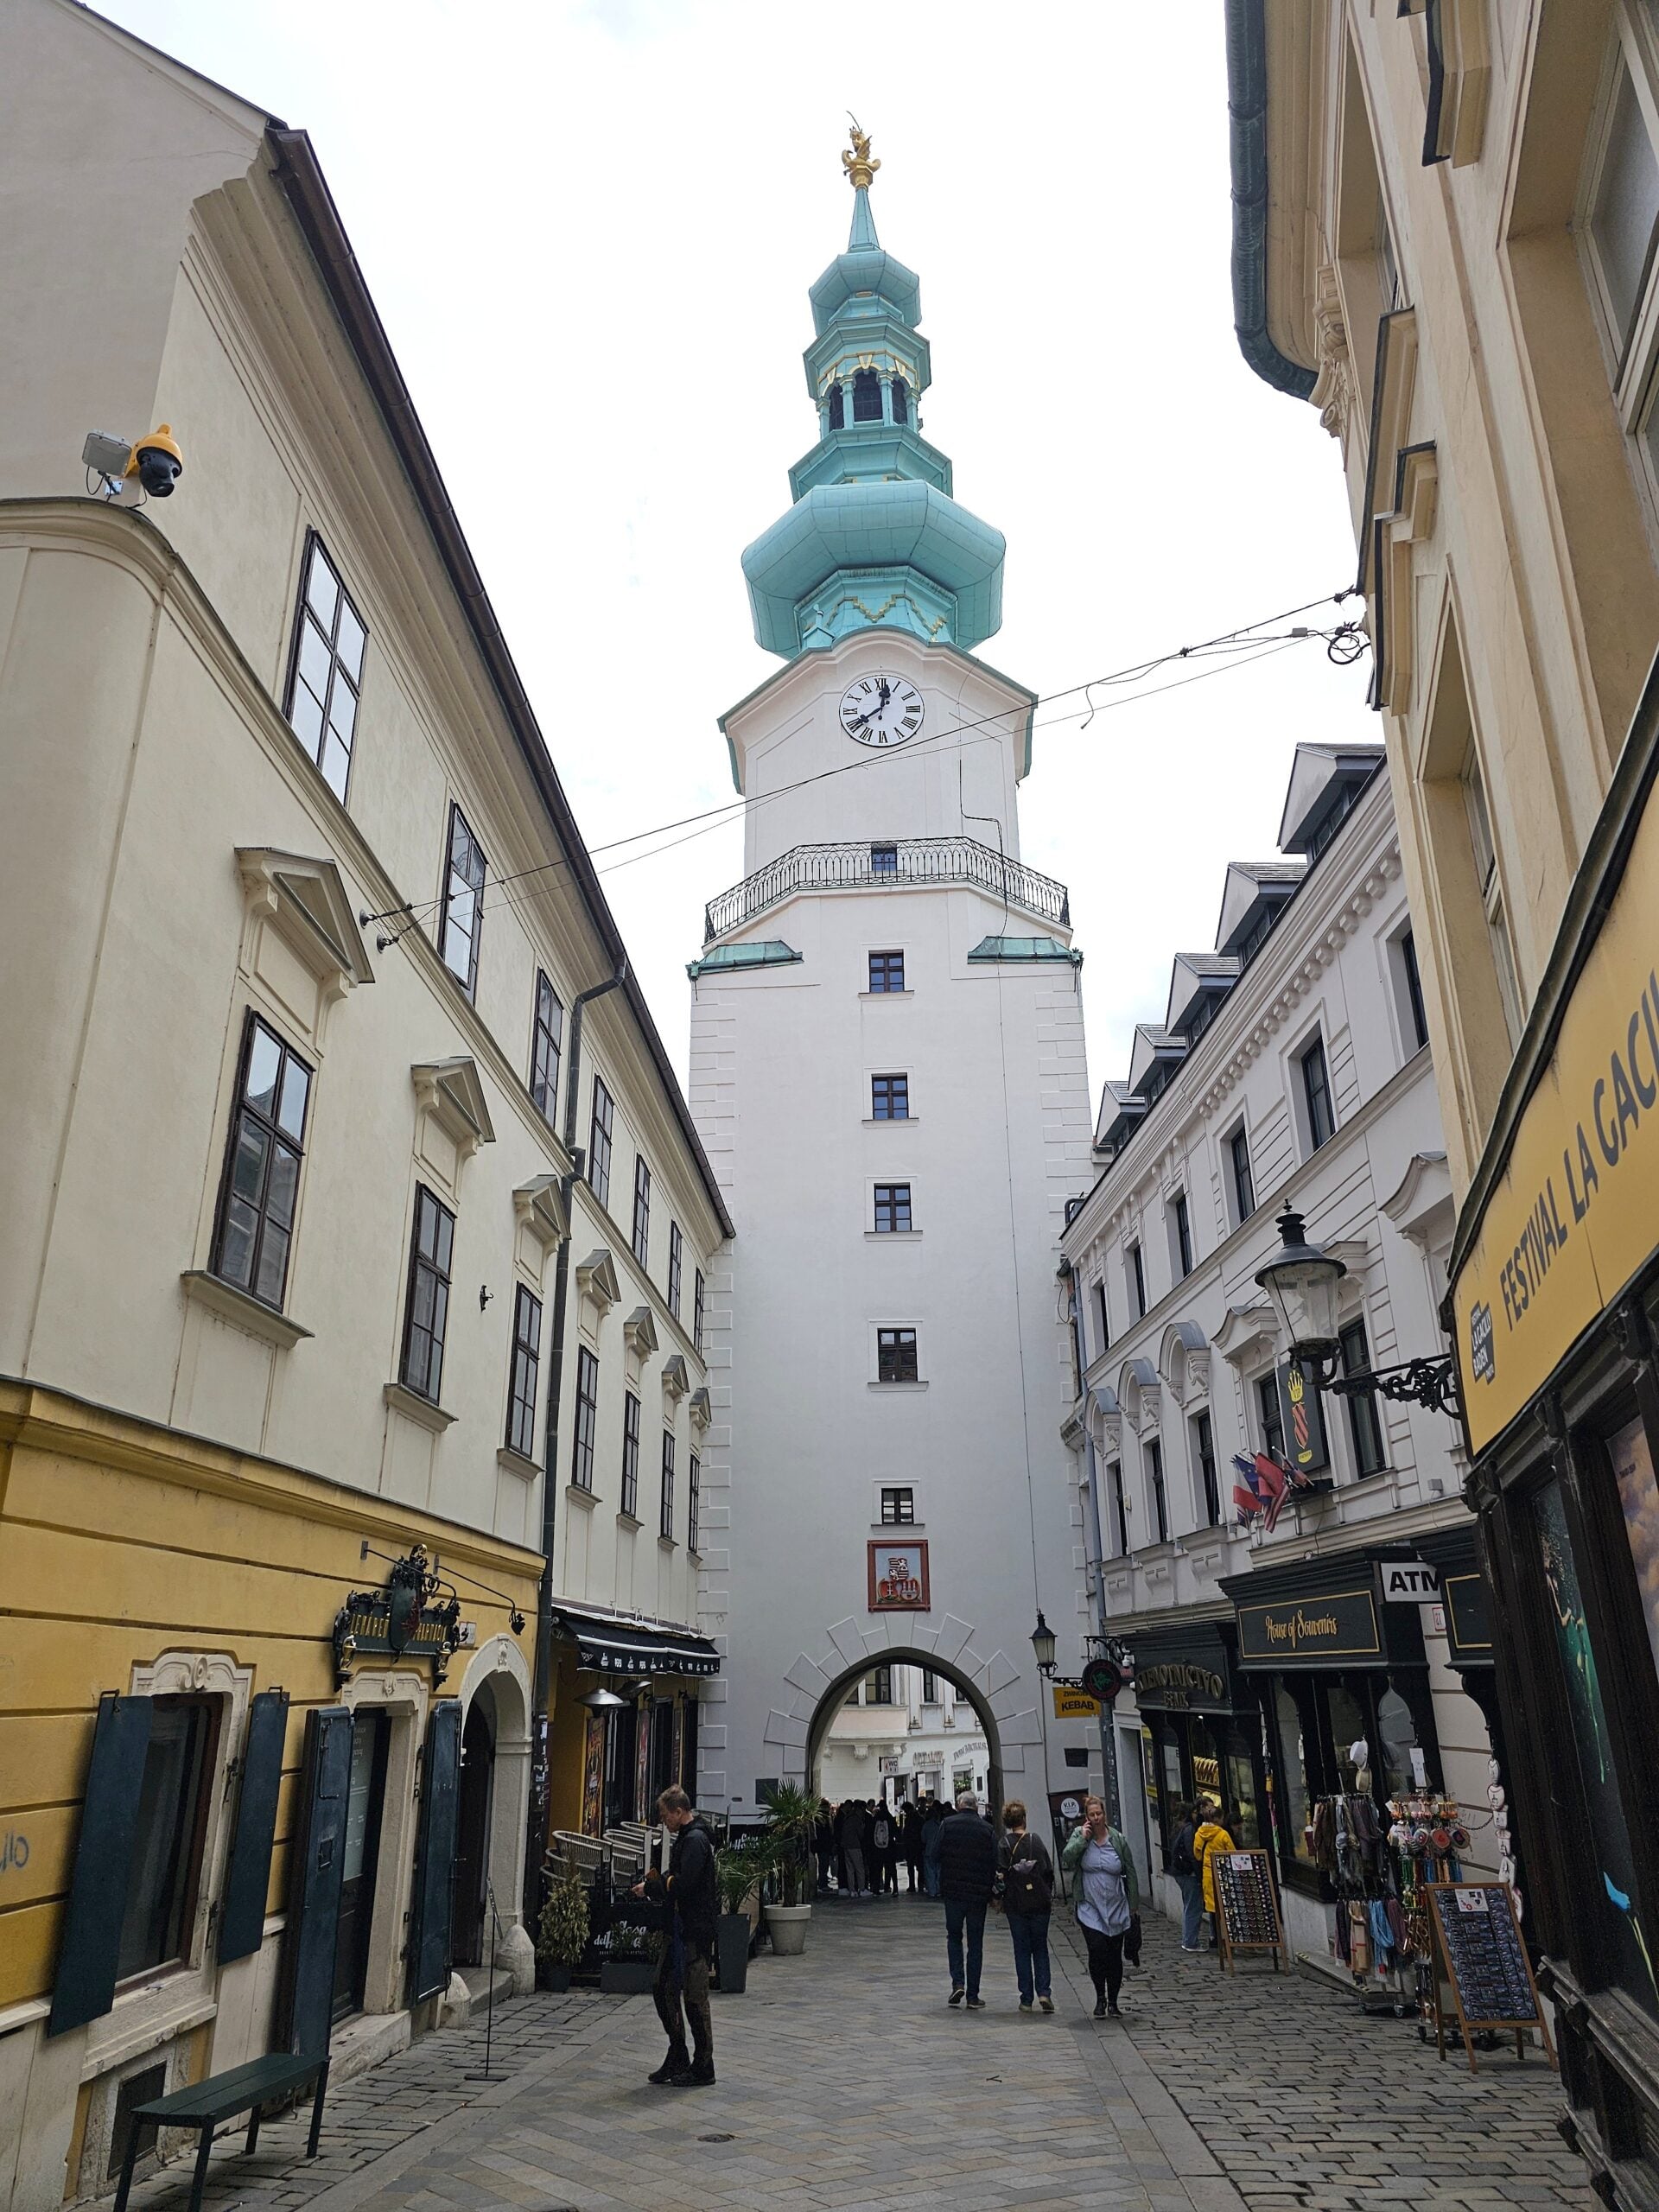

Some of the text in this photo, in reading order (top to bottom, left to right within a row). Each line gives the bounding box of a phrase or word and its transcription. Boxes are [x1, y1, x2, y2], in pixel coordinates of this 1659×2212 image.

[858, 681, 873, 695] XI
[893, 681, 901, 692] I
[847, 693, 862, 702] X
[901, 691, 915, 701] II
[859, 727, 874, 741] VII
[879, 731, 888, 743] VI
[893, 727, 905, 739] V
[1499, 1176, 1567, 1332] FESTIVAL
[1564, 1121, 1599, 1225] LA
[1389, 1571, 1440, 1592] ATM
[1265, 1609, 1338, 1649] House of Souvenirs
[1061, 1700, 1095, 1712] KEBAB
